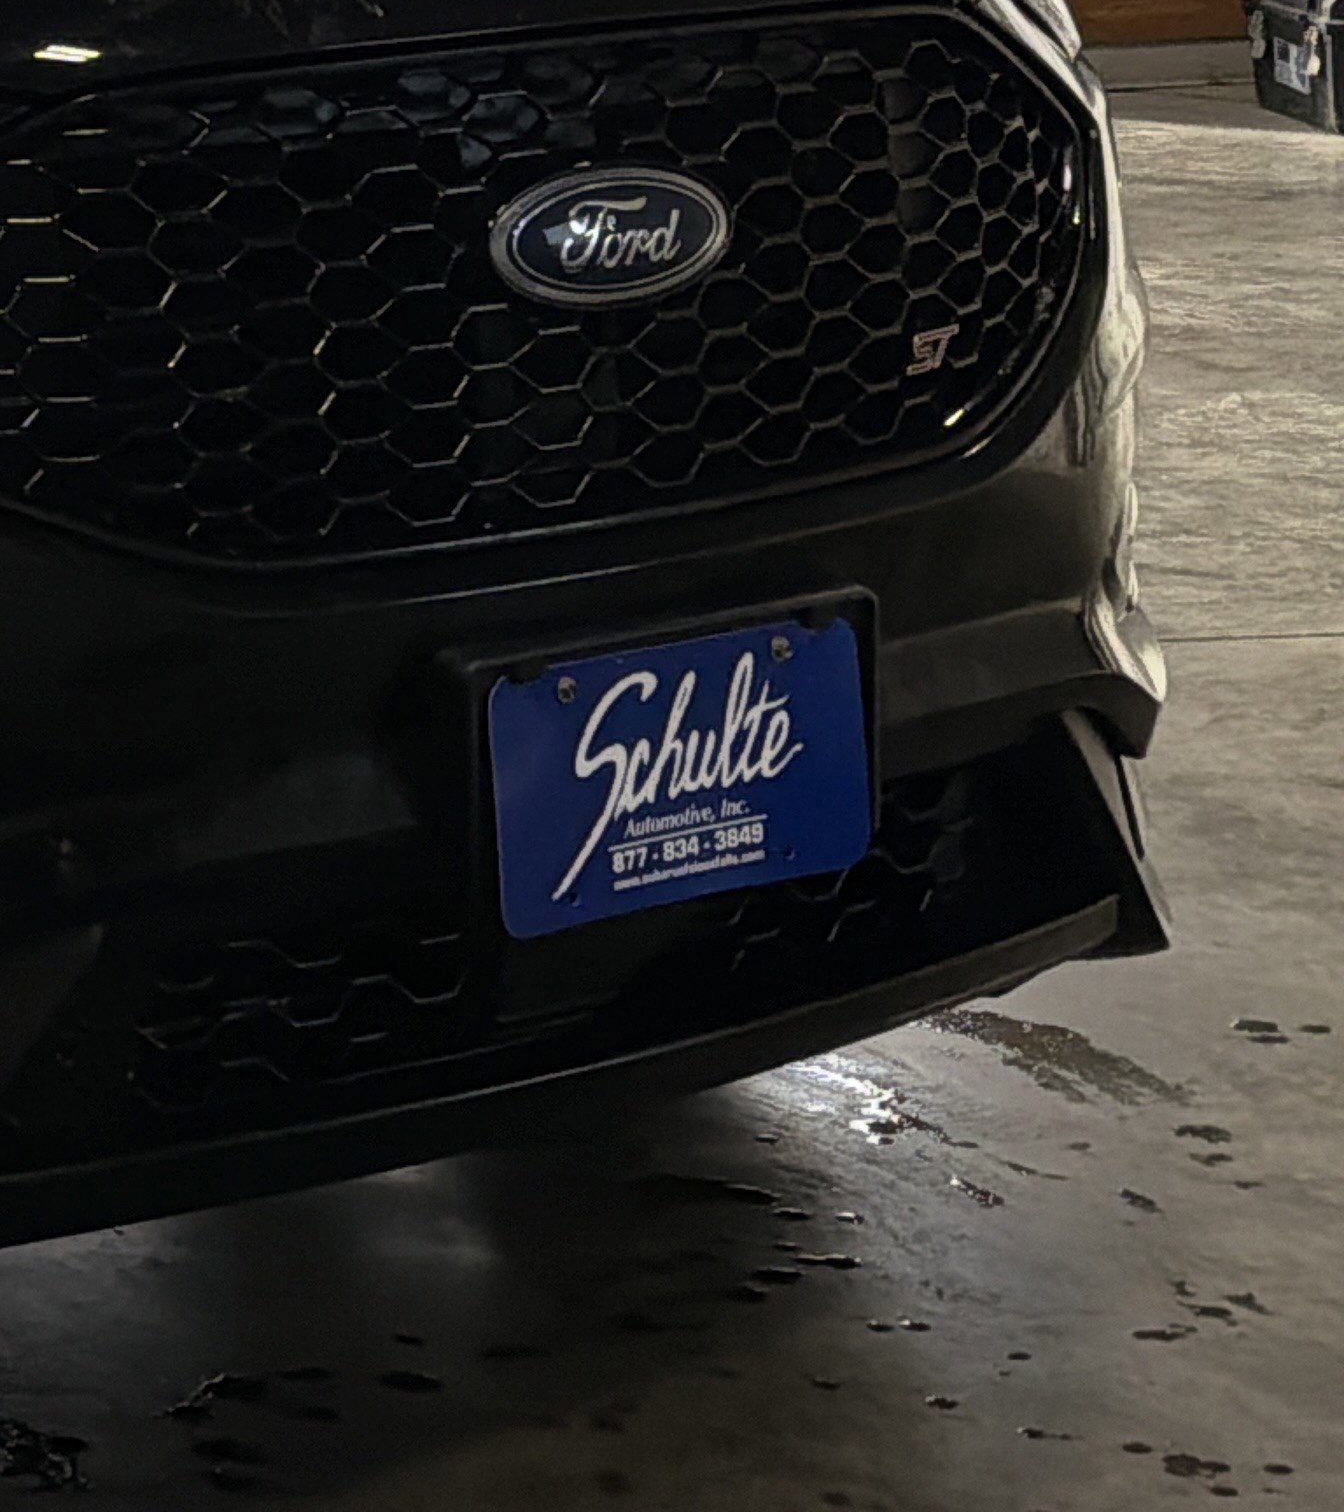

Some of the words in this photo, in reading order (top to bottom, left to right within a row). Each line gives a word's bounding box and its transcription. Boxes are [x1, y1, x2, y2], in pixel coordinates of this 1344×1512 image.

[561, 195, 682, 273] Ford
[906, 323, 960, 376] ST
[553, 652, 803, 902] Schulte
[624, 803, 716, 838] Automotive,
[721, 798, 750, 818] Inc.
[613, 847, 648, 873] 877
[663, 836, 700, 862] 834
[714, 822, 764, 851] 3849
